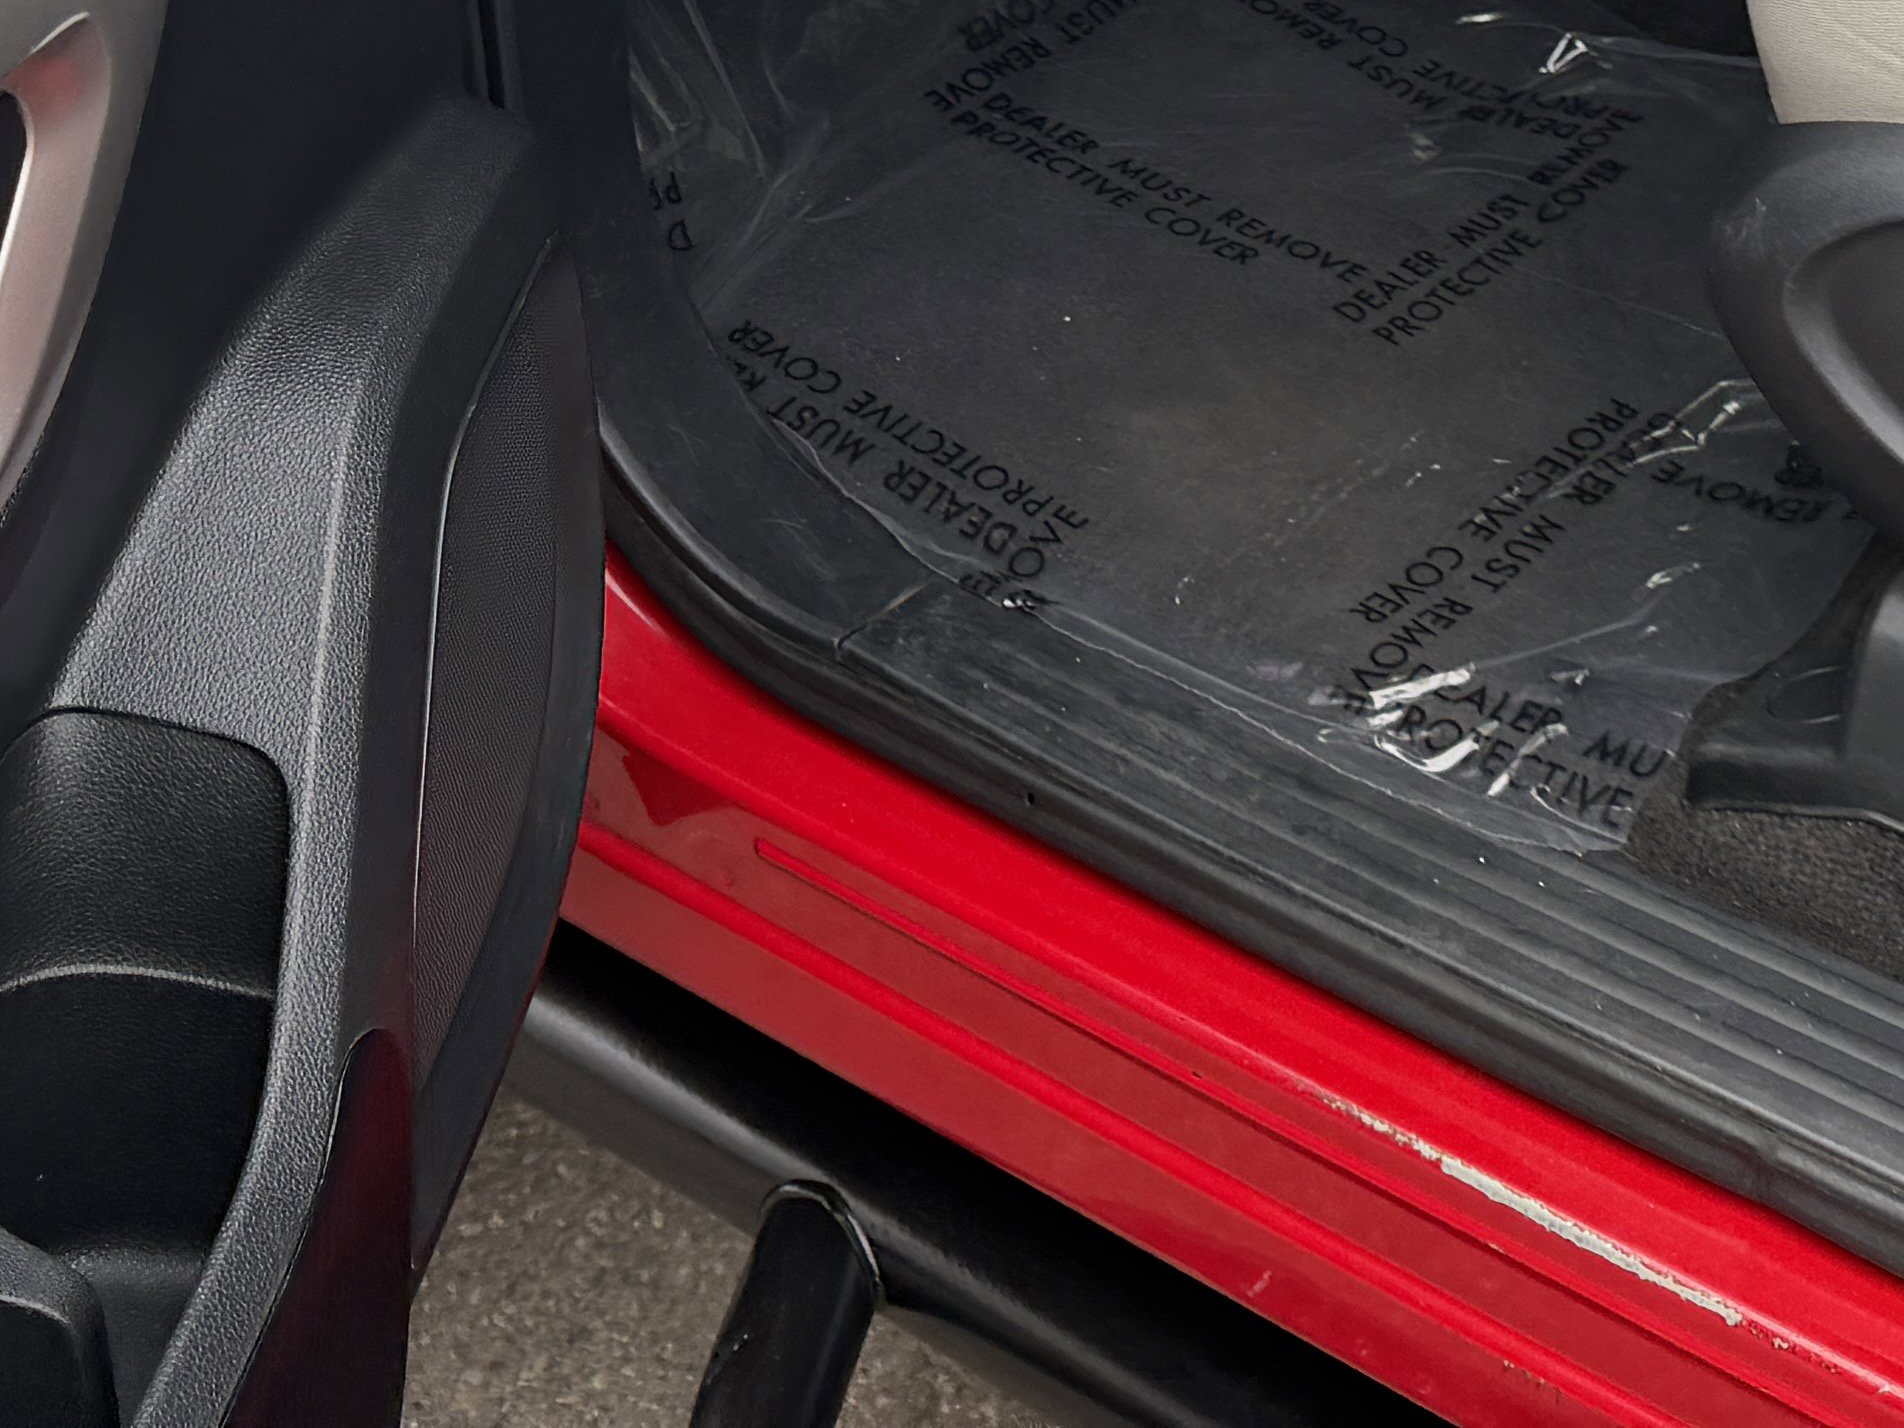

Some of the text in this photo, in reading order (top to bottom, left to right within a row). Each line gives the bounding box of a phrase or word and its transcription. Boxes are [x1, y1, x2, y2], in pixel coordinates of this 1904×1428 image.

[924, 35, 1052, 112] REMOVE
[1348, 55, 1446, 112] MUST
[949, 109, 1260, 266] PROTECTIVE COVER
[983, 93, 1370, 284] DEALER MUST REMOVE
[1331, 109, 1645, 323] DEALER MUST REMOVE
[1371, 157, 1632, 346] PROTECTIVE COVER
[727, 320, 1058, 519] PROTECTIVE COVER
[766, 394, 1018, 557] DEALER MUST
[1457, 395, 1639, 546] PROTECTIVE
[1648, 456, 1834, 524] REMOVE
[1349, 544, 1464, 626] COVER
[1469, 512, 1568, 596] MUST
